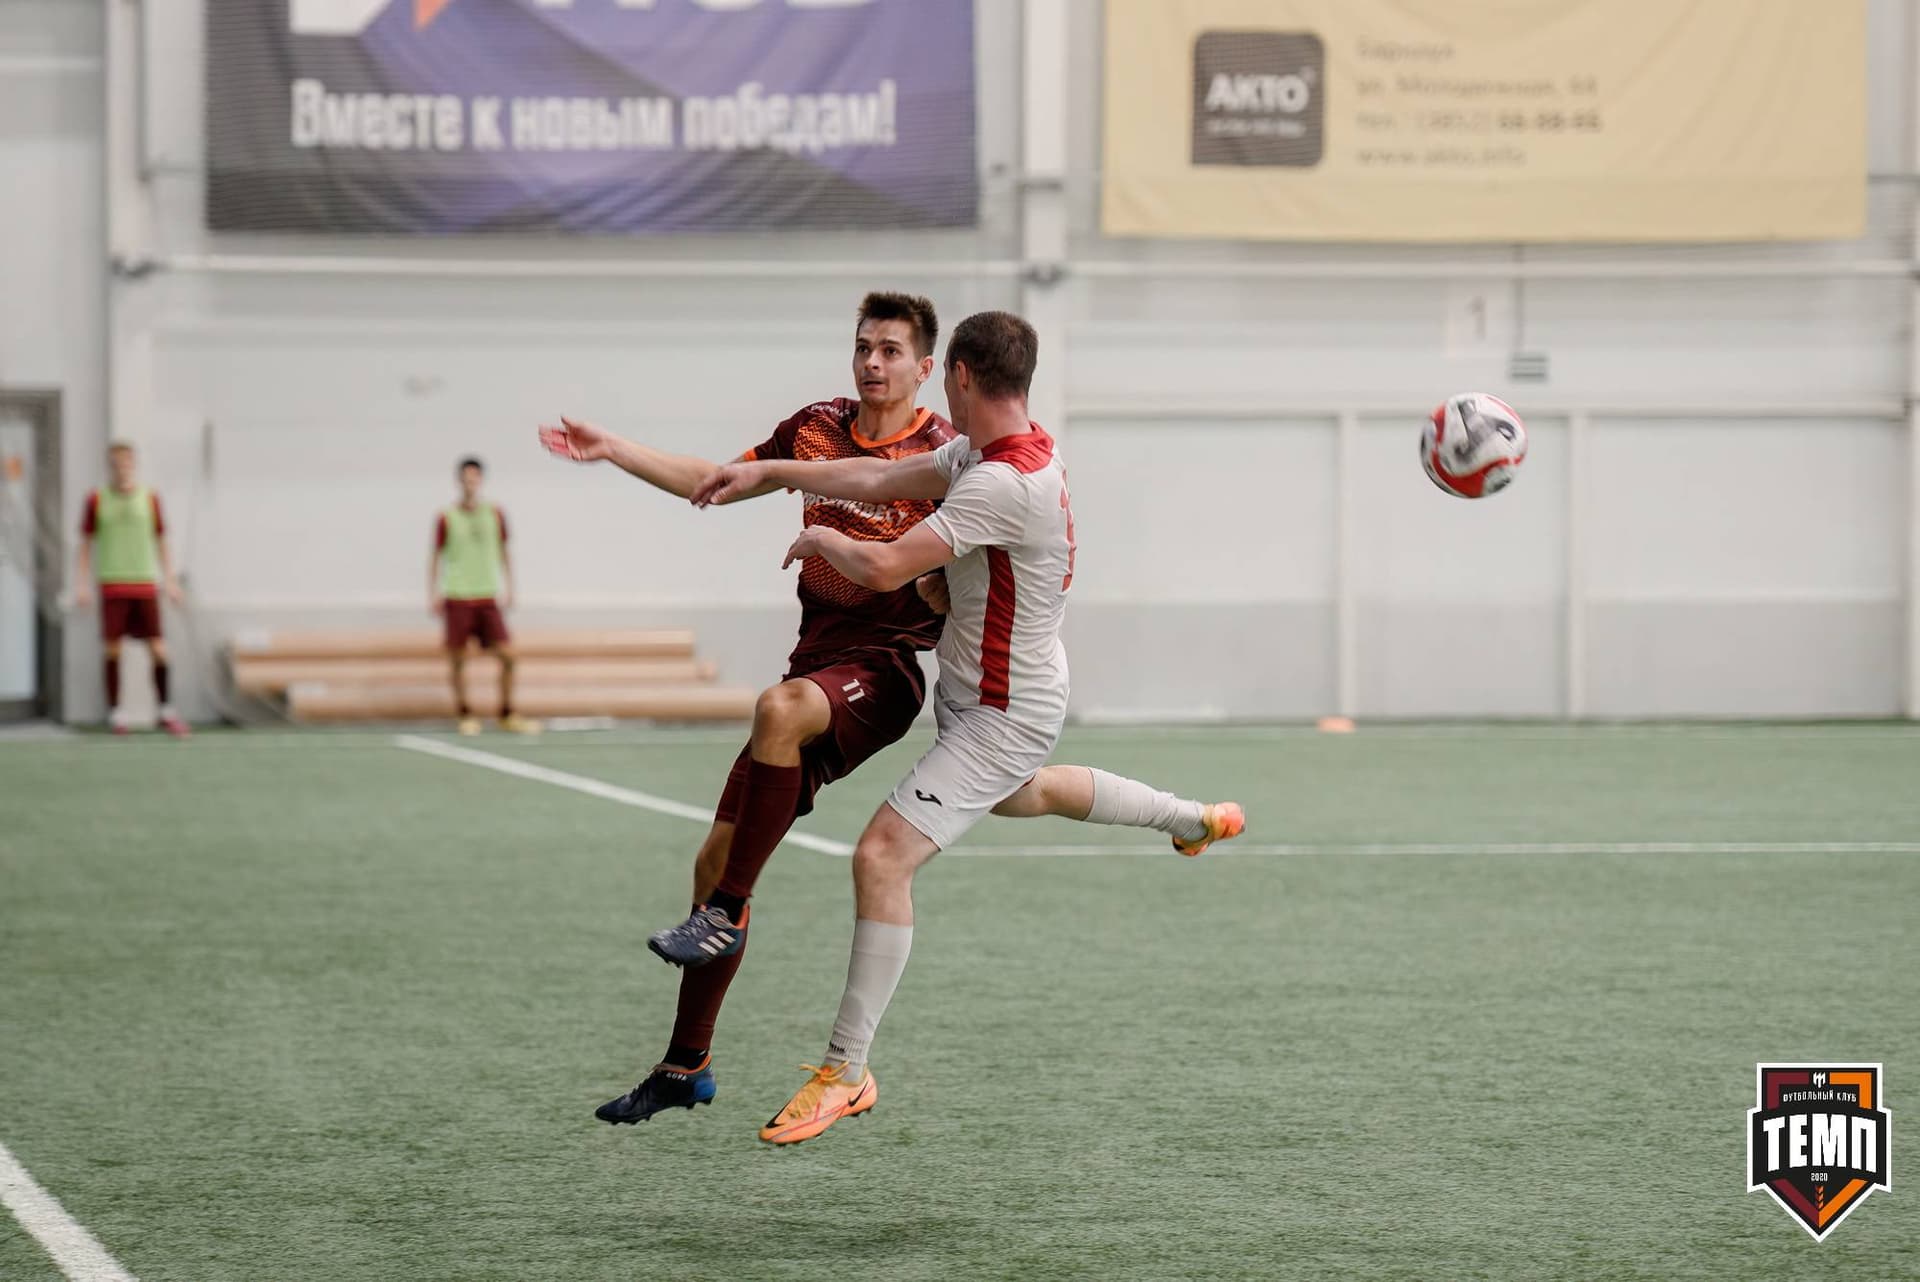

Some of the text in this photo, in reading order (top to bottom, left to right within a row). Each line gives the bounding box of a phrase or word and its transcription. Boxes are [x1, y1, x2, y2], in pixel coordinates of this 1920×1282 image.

[291, 79, 896, 153] Вместе к новым победам!
[841, 679, 865, 702] 11
